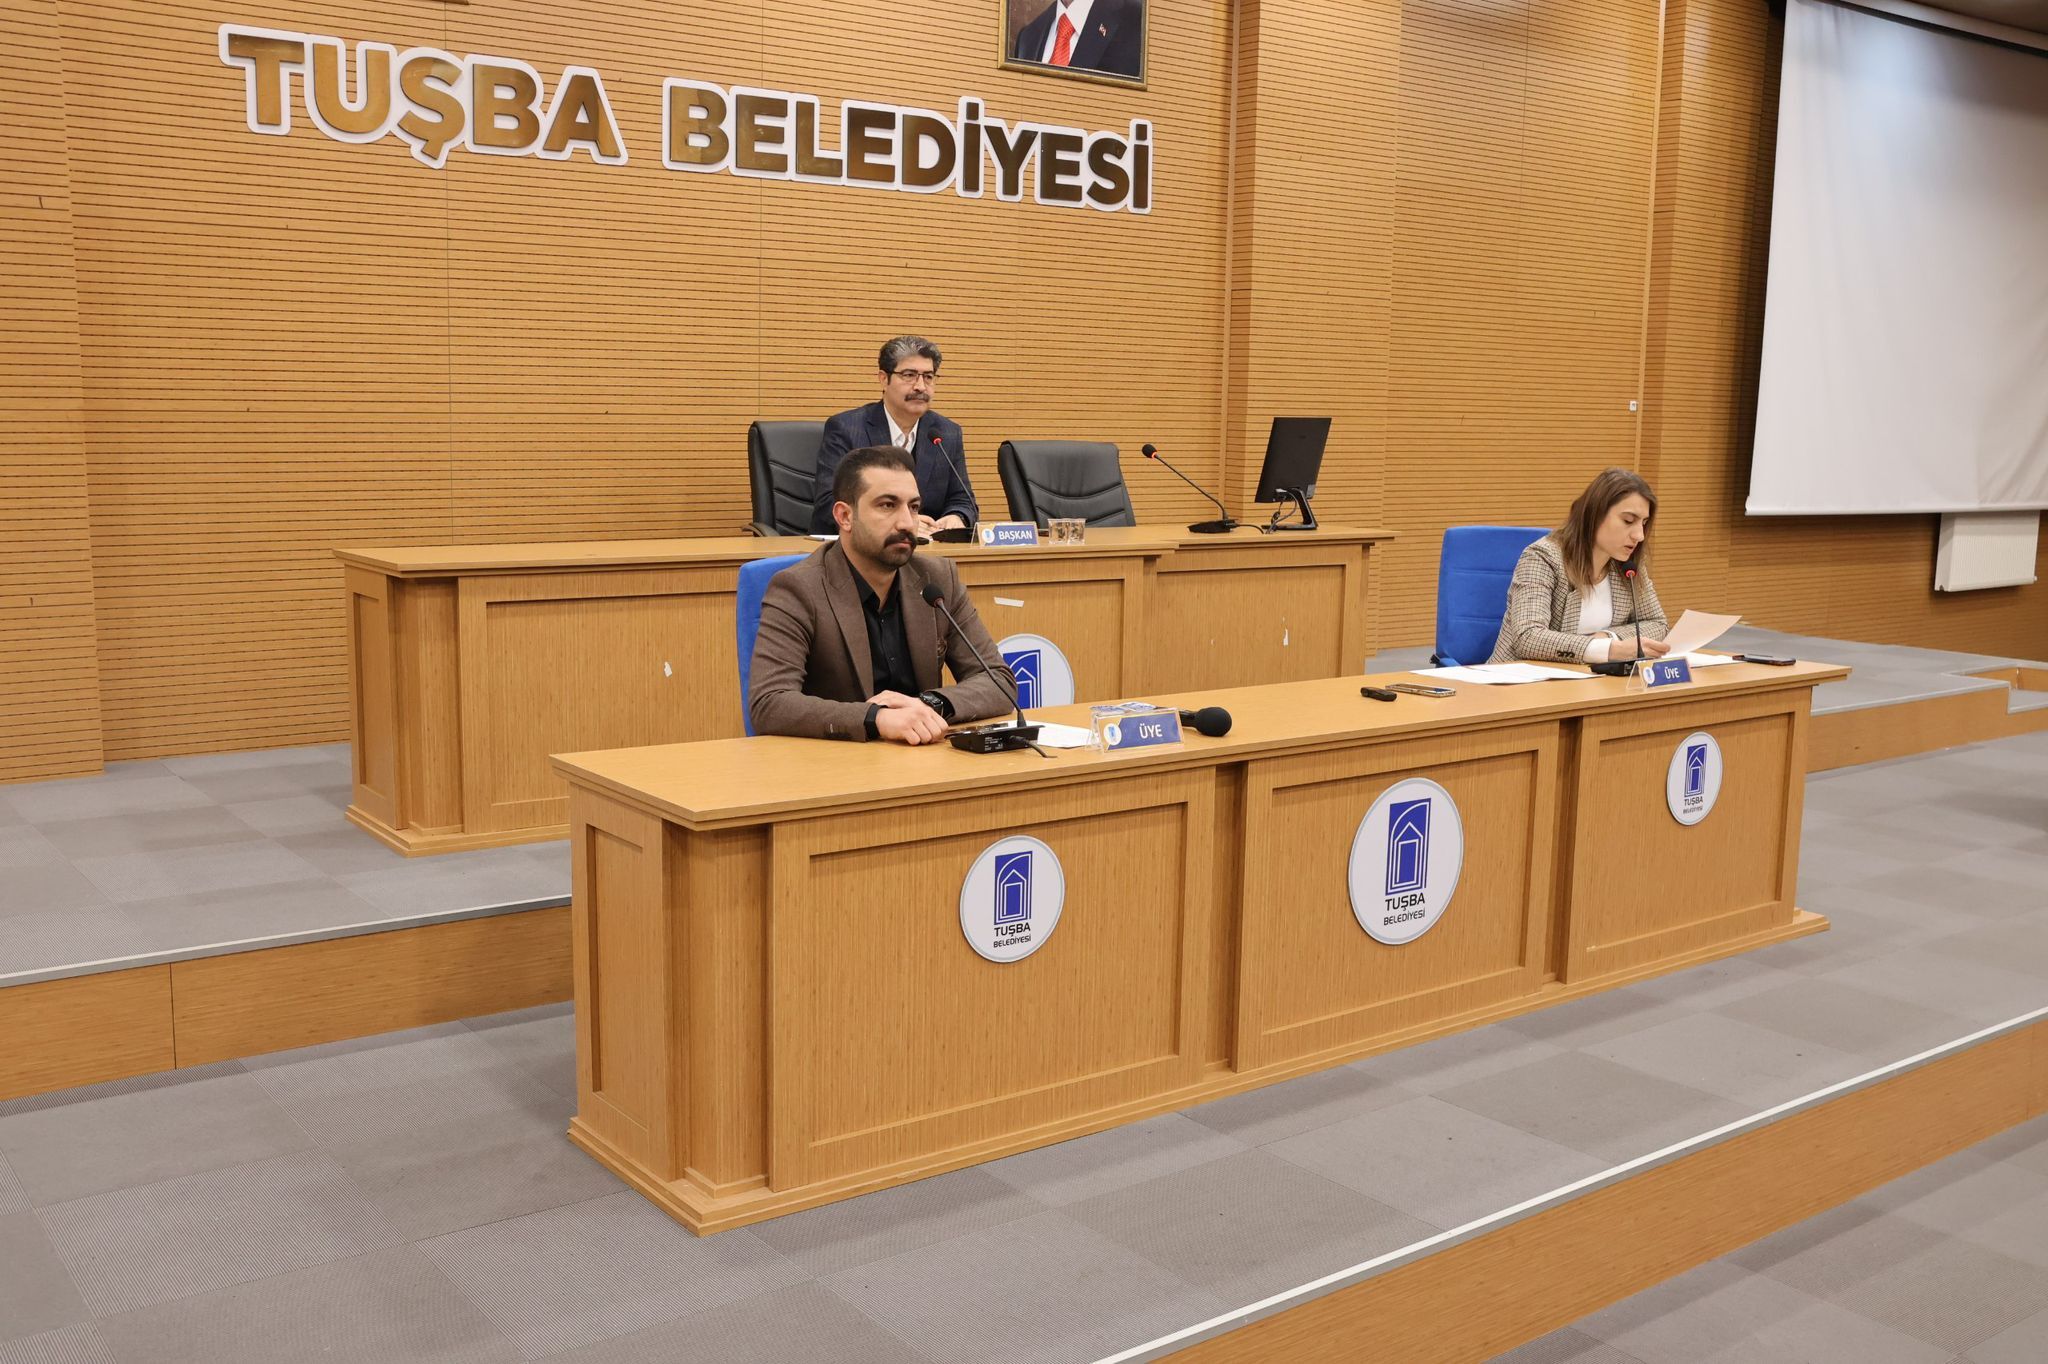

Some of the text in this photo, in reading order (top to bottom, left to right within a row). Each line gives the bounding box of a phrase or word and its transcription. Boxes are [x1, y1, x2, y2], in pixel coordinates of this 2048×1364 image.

[226, 32, 1150, 210] TUŞBA BELEDİYESİ
[998, 530, 1033, 542] BAŞKAN
[1664, 666, 1680, 680] ÜYE
[1139, 723, 1163, 739] ÜYE
[1684, 796, 1703, 806] TUŞBA
[1385, 892, 1425, 911] TUŞBA
[1383, 908, 1426, 926] BELEDİYESİ
[994, 922, 1031, 937] TUŞBA
[993, 934, 1031, 948] BELEDİYESİ
